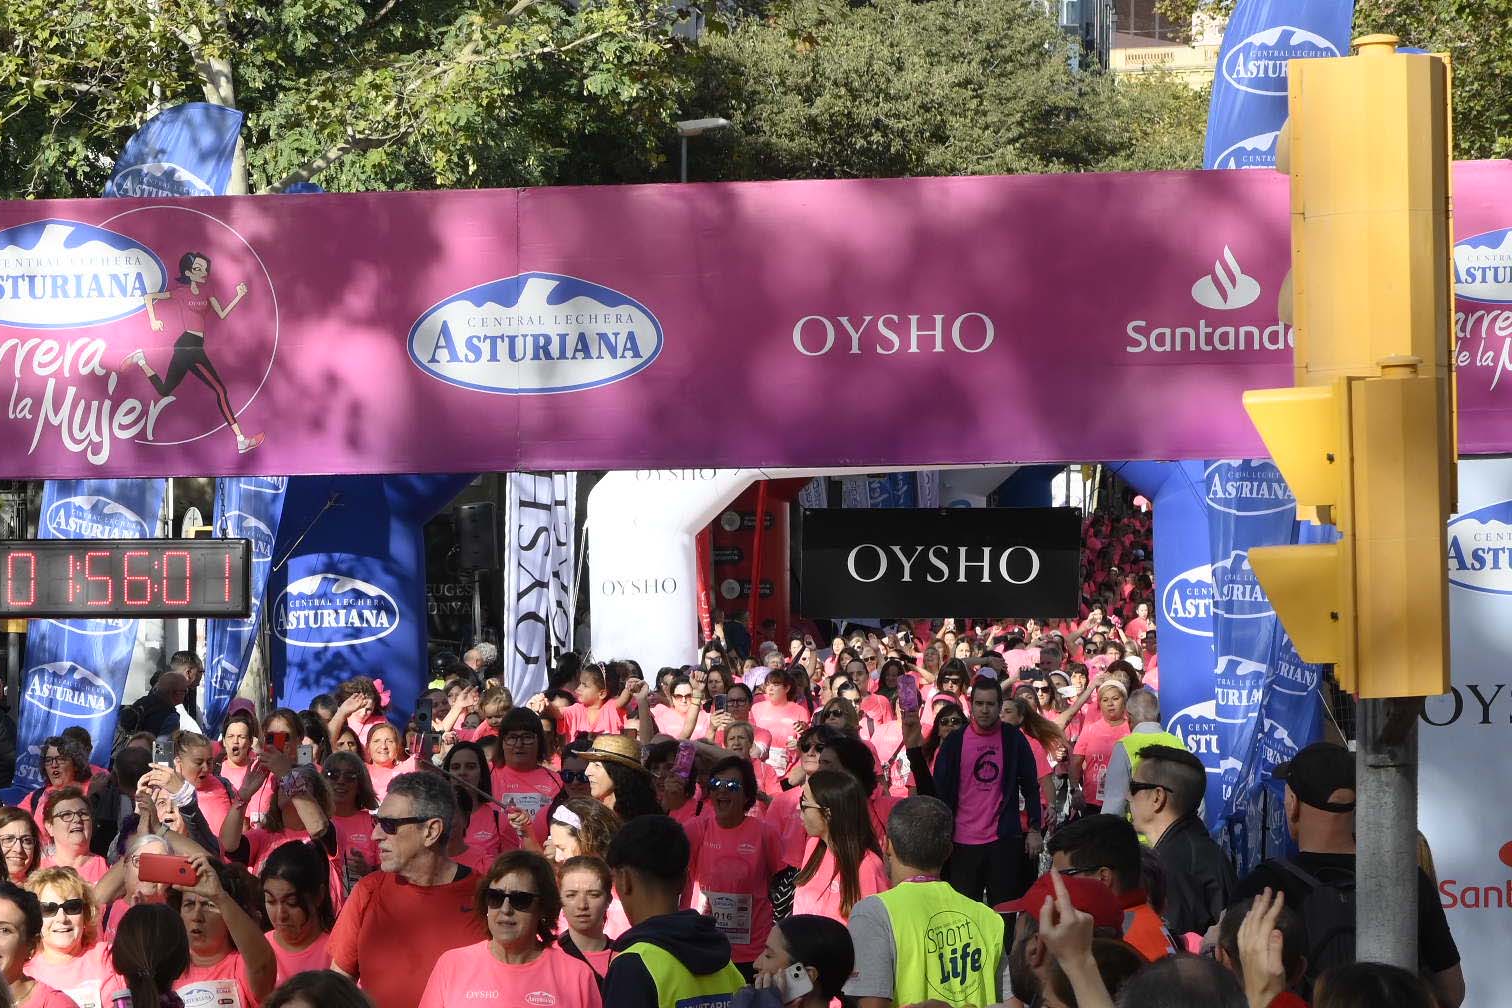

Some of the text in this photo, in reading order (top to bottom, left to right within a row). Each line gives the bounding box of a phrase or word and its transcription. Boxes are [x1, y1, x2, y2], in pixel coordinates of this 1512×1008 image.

[61, 254, 143, 268] LECHERA
[468, 312, 635, 328] CENTRAL LECHERA
[793, 312, 995, 357] OYSHO
[427, 321, 643, 365] ASTURIANA
[7, 380, 33, 421] la
[28, 372, 177, 466] Mujer
[7, 552, 231, 606] 01:56:01
[847, 543, 1041, 585] OYSHO
[289, 598, 385, 608] CENTRAL LECHERA
[602, 577, 677, 596] OYSHO
[277, 607, 390, 630] ASTURIANA
[27, 676, 106, 711] ASTURIANA
[927, 918, 973, 955] Sport
[938, 942, 983, 986] Life
